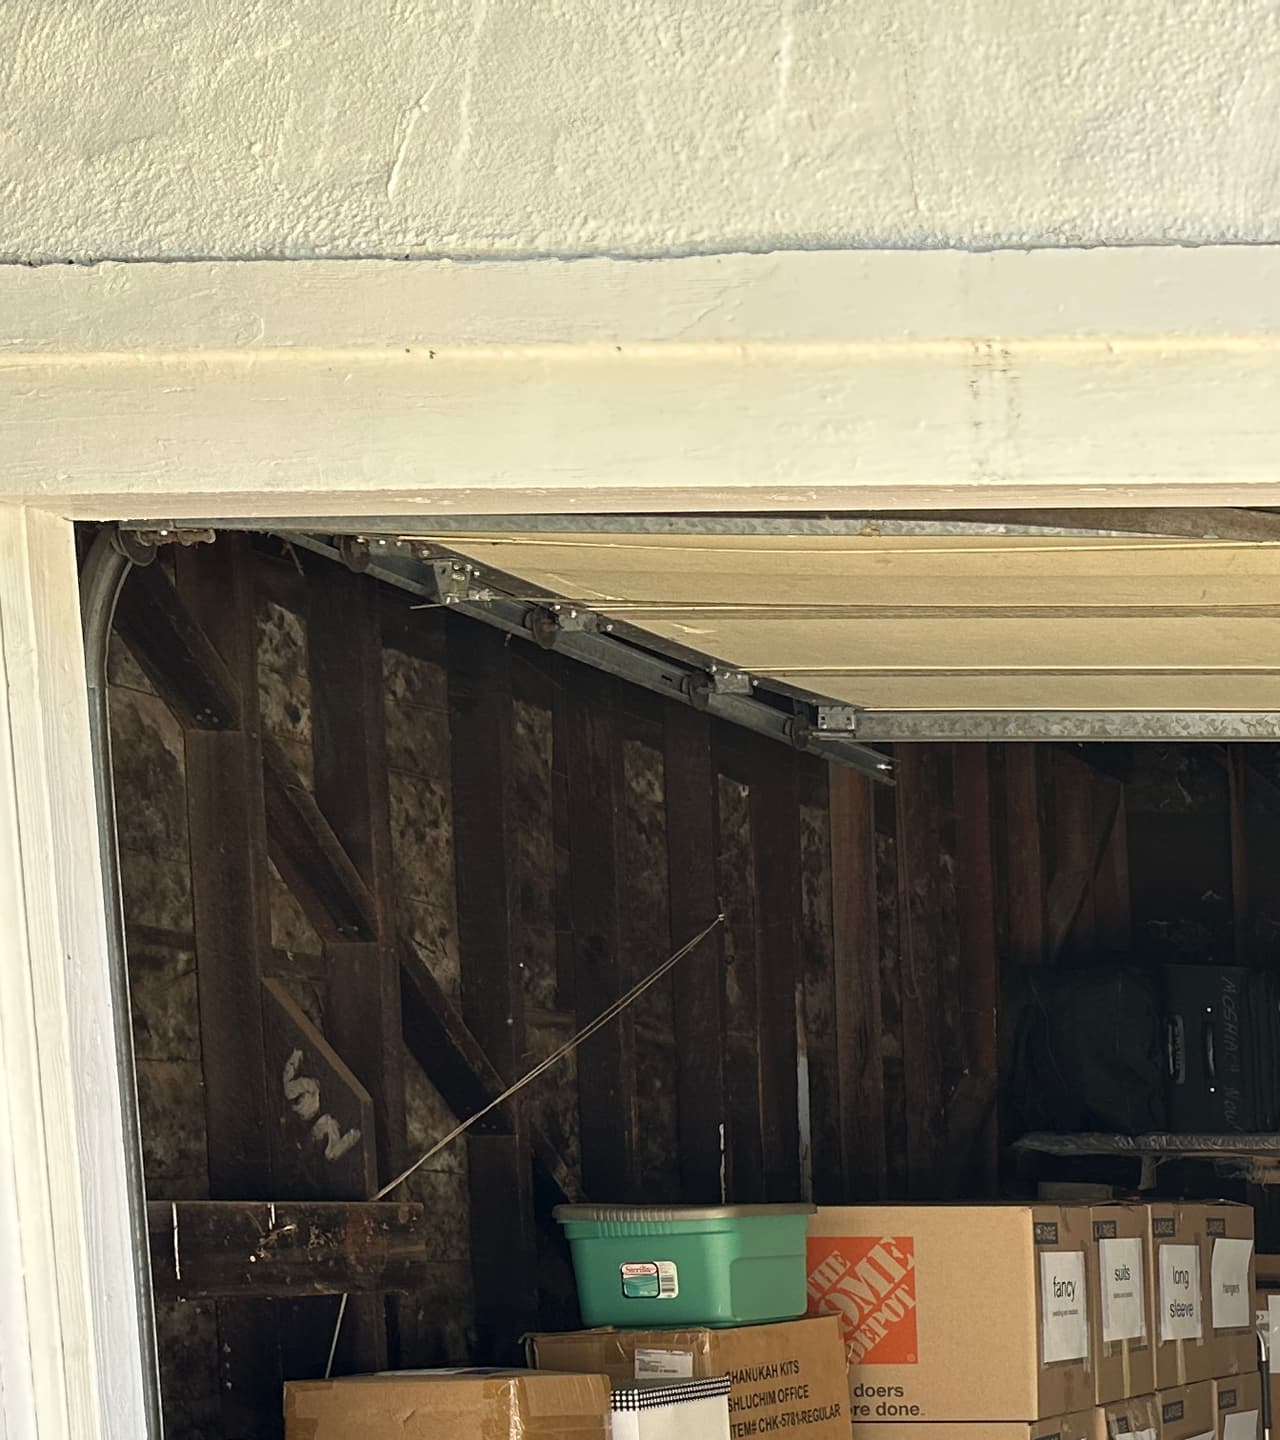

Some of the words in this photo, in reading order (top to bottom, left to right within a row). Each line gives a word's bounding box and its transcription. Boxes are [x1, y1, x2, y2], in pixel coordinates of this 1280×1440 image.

[807, 1249, 851, 1297] THE
[819, 1236, 916, 1332] OME
[1114, 1264, 1131, 1281] suits
[1173, 1265, 1189, 1289] long
[1053, 1276, 1076, 1302] fancy
[1169, 1299, 1194, 1318] sleeve
[846, 1284, 916, 1363] DEPOT
[780, 1360, 800, 1376] KITS
[728, 1389, 776, 1413] SHLUCHIM
[778, 1384, 809, 1403] OFFICE
[854, 1383, 904, 1397] doers
[731, 1420, 757, 1440] TEM#
[759, 1403, 841, 1433] CHK-5781-REGULAR
[850, 1404, 870, 1417] re
